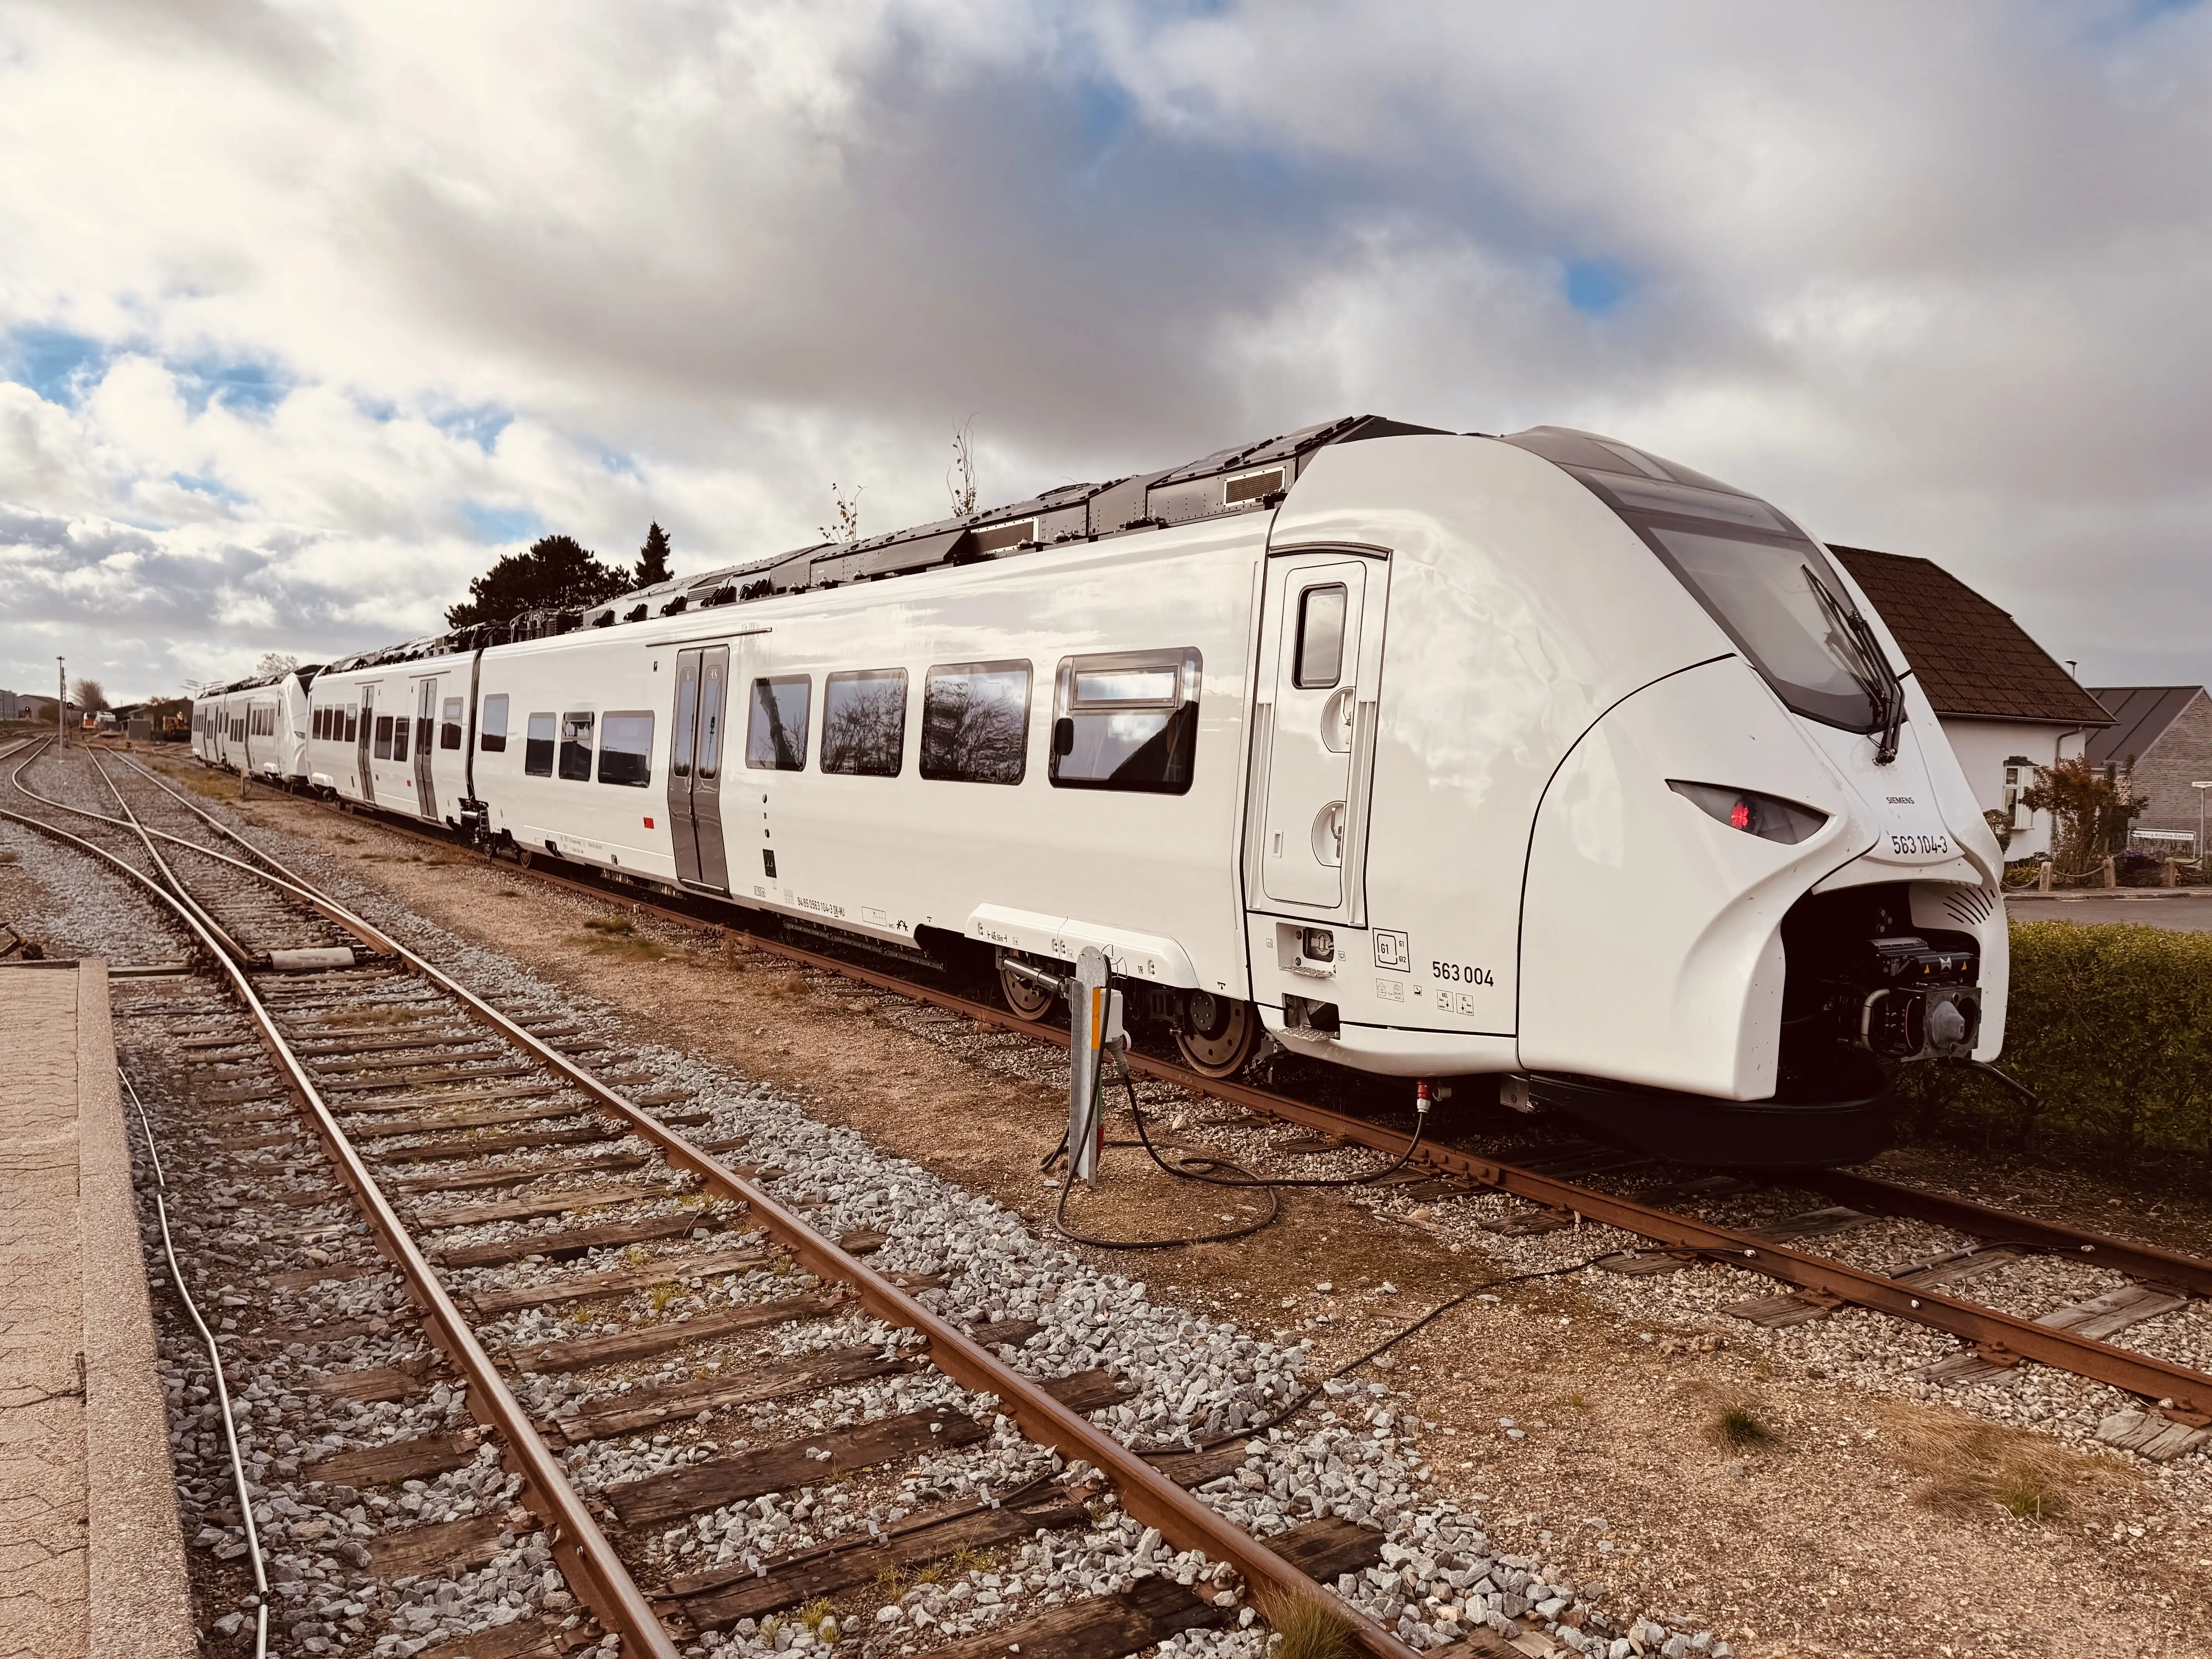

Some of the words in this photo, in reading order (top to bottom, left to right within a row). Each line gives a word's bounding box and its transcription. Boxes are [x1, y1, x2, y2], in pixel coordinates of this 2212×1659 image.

[1891, 836, 1917, 854] 563
[1917, 836, 1948, 854] 104-3
[798, 897, 803, 906] 94
[803, 898, 809, 907] 86
[809, 900, 820, 910] 0563
[821, 902, 833, 914] 104-3
[1381, 943, 1389, 954] G1
[1138, 965, 1143, 974] 1R
[1432, 961, 1460, 981] 563
[1464, 966, 1494, 987] 004
